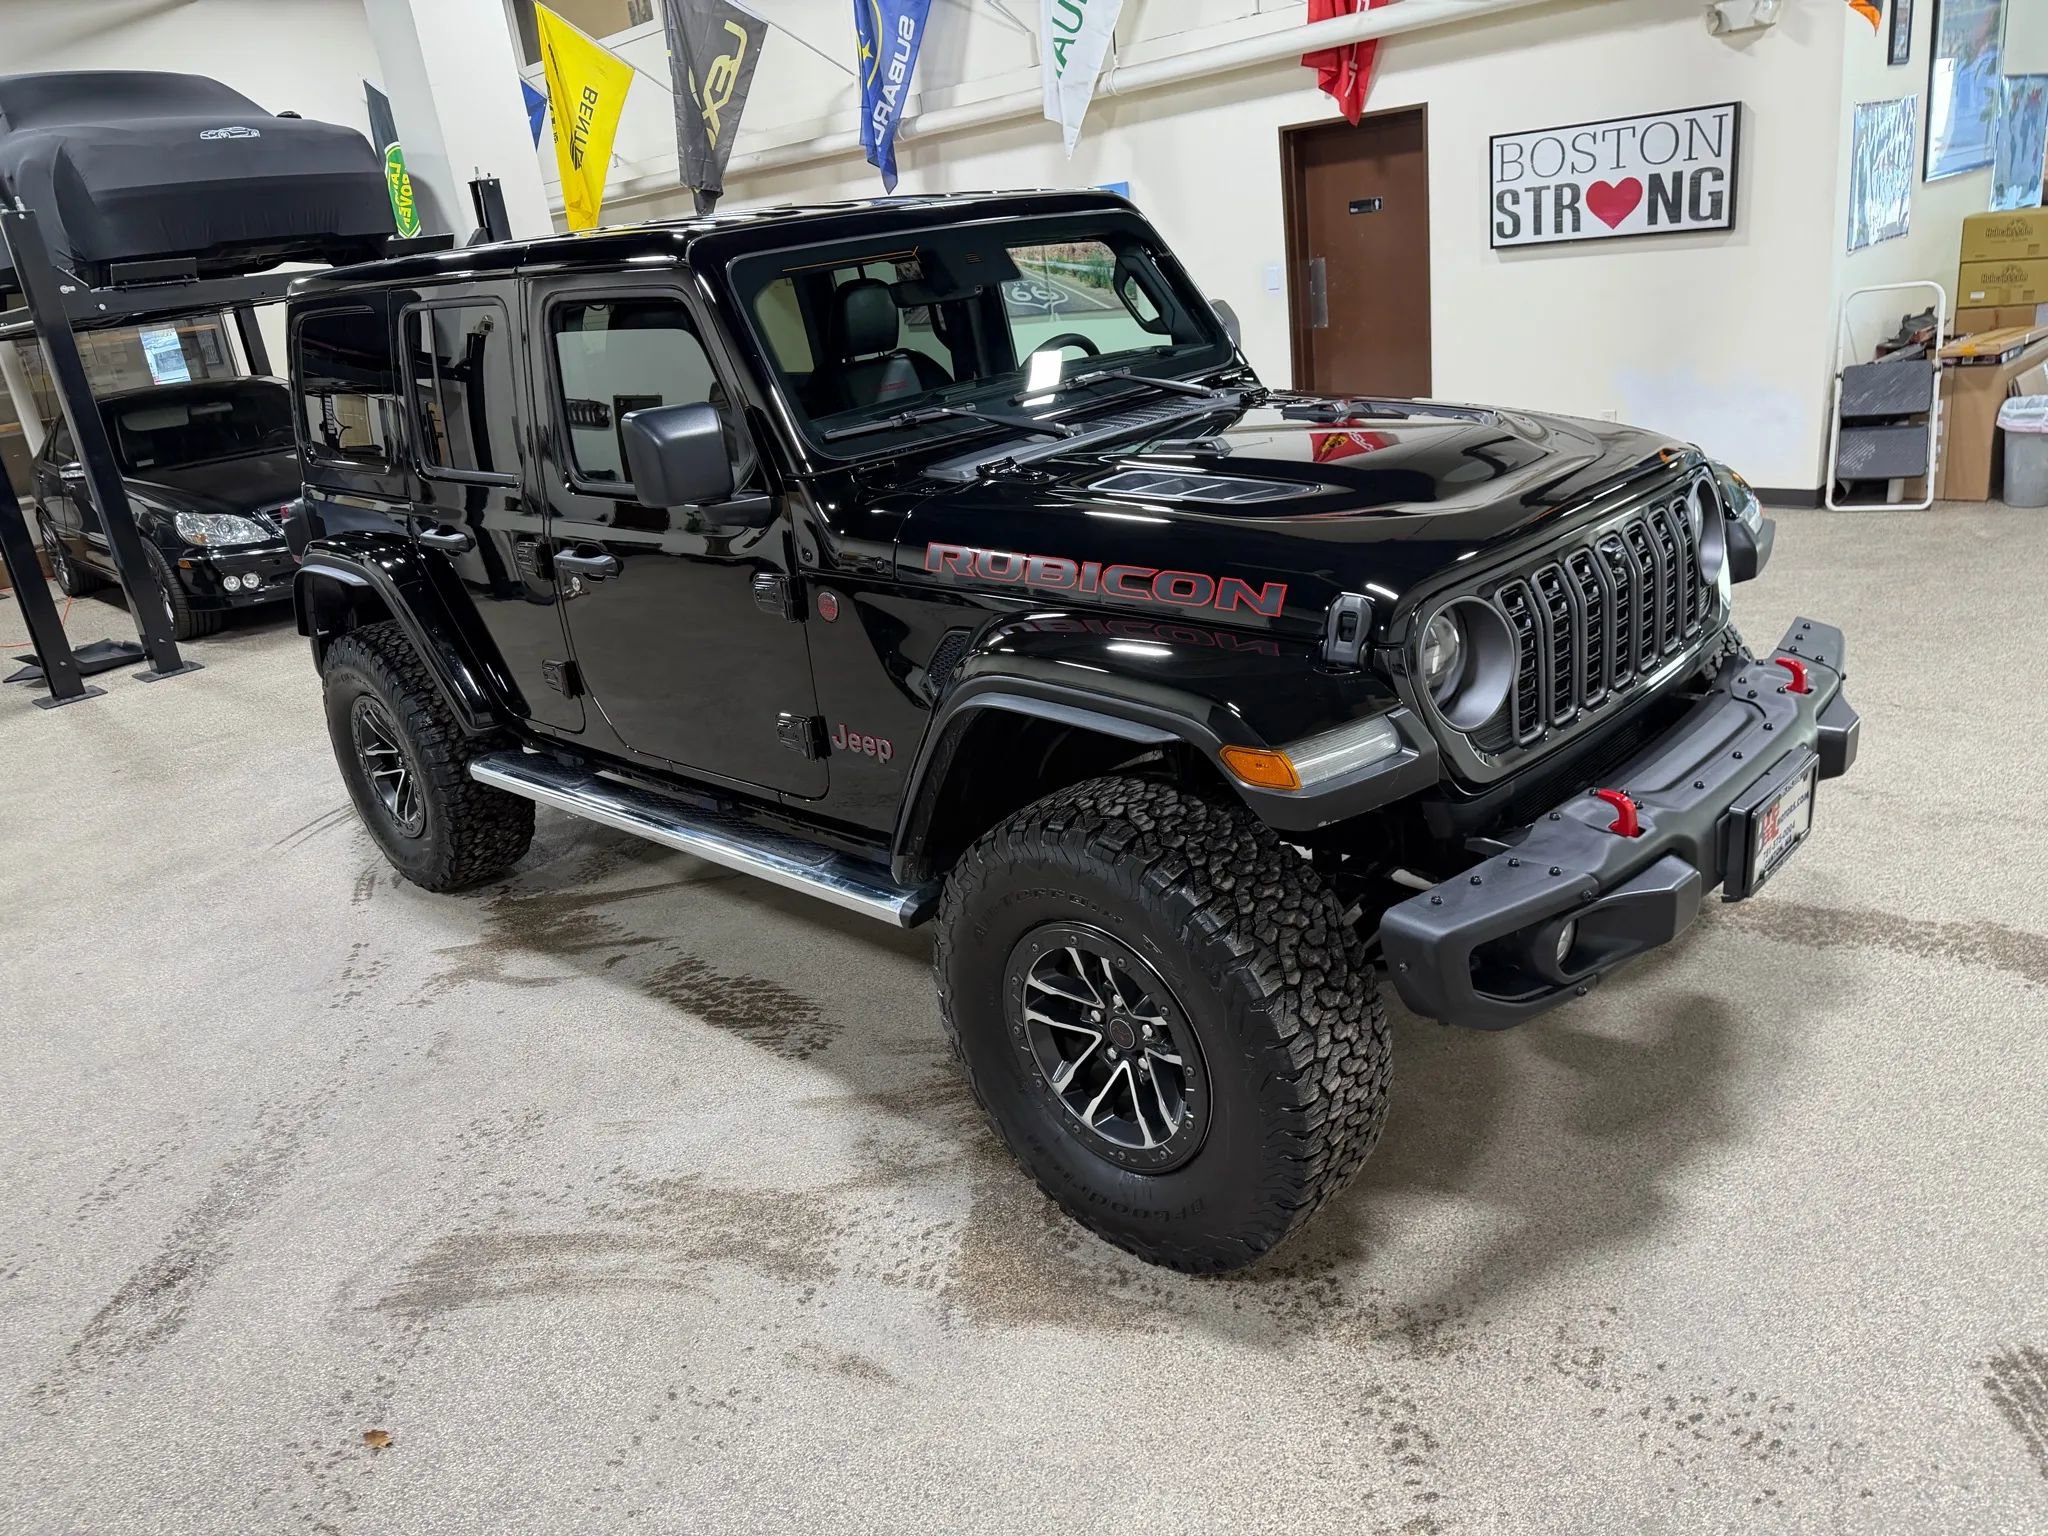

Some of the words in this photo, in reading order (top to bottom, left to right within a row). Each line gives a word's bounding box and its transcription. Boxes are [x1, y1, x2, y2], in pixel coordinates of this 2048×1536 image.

[1495, 112, 1729, 184] BOSTON
[925, 541, 1288, 618] RUBICON
[831, 722, 894, 764] Jeep
